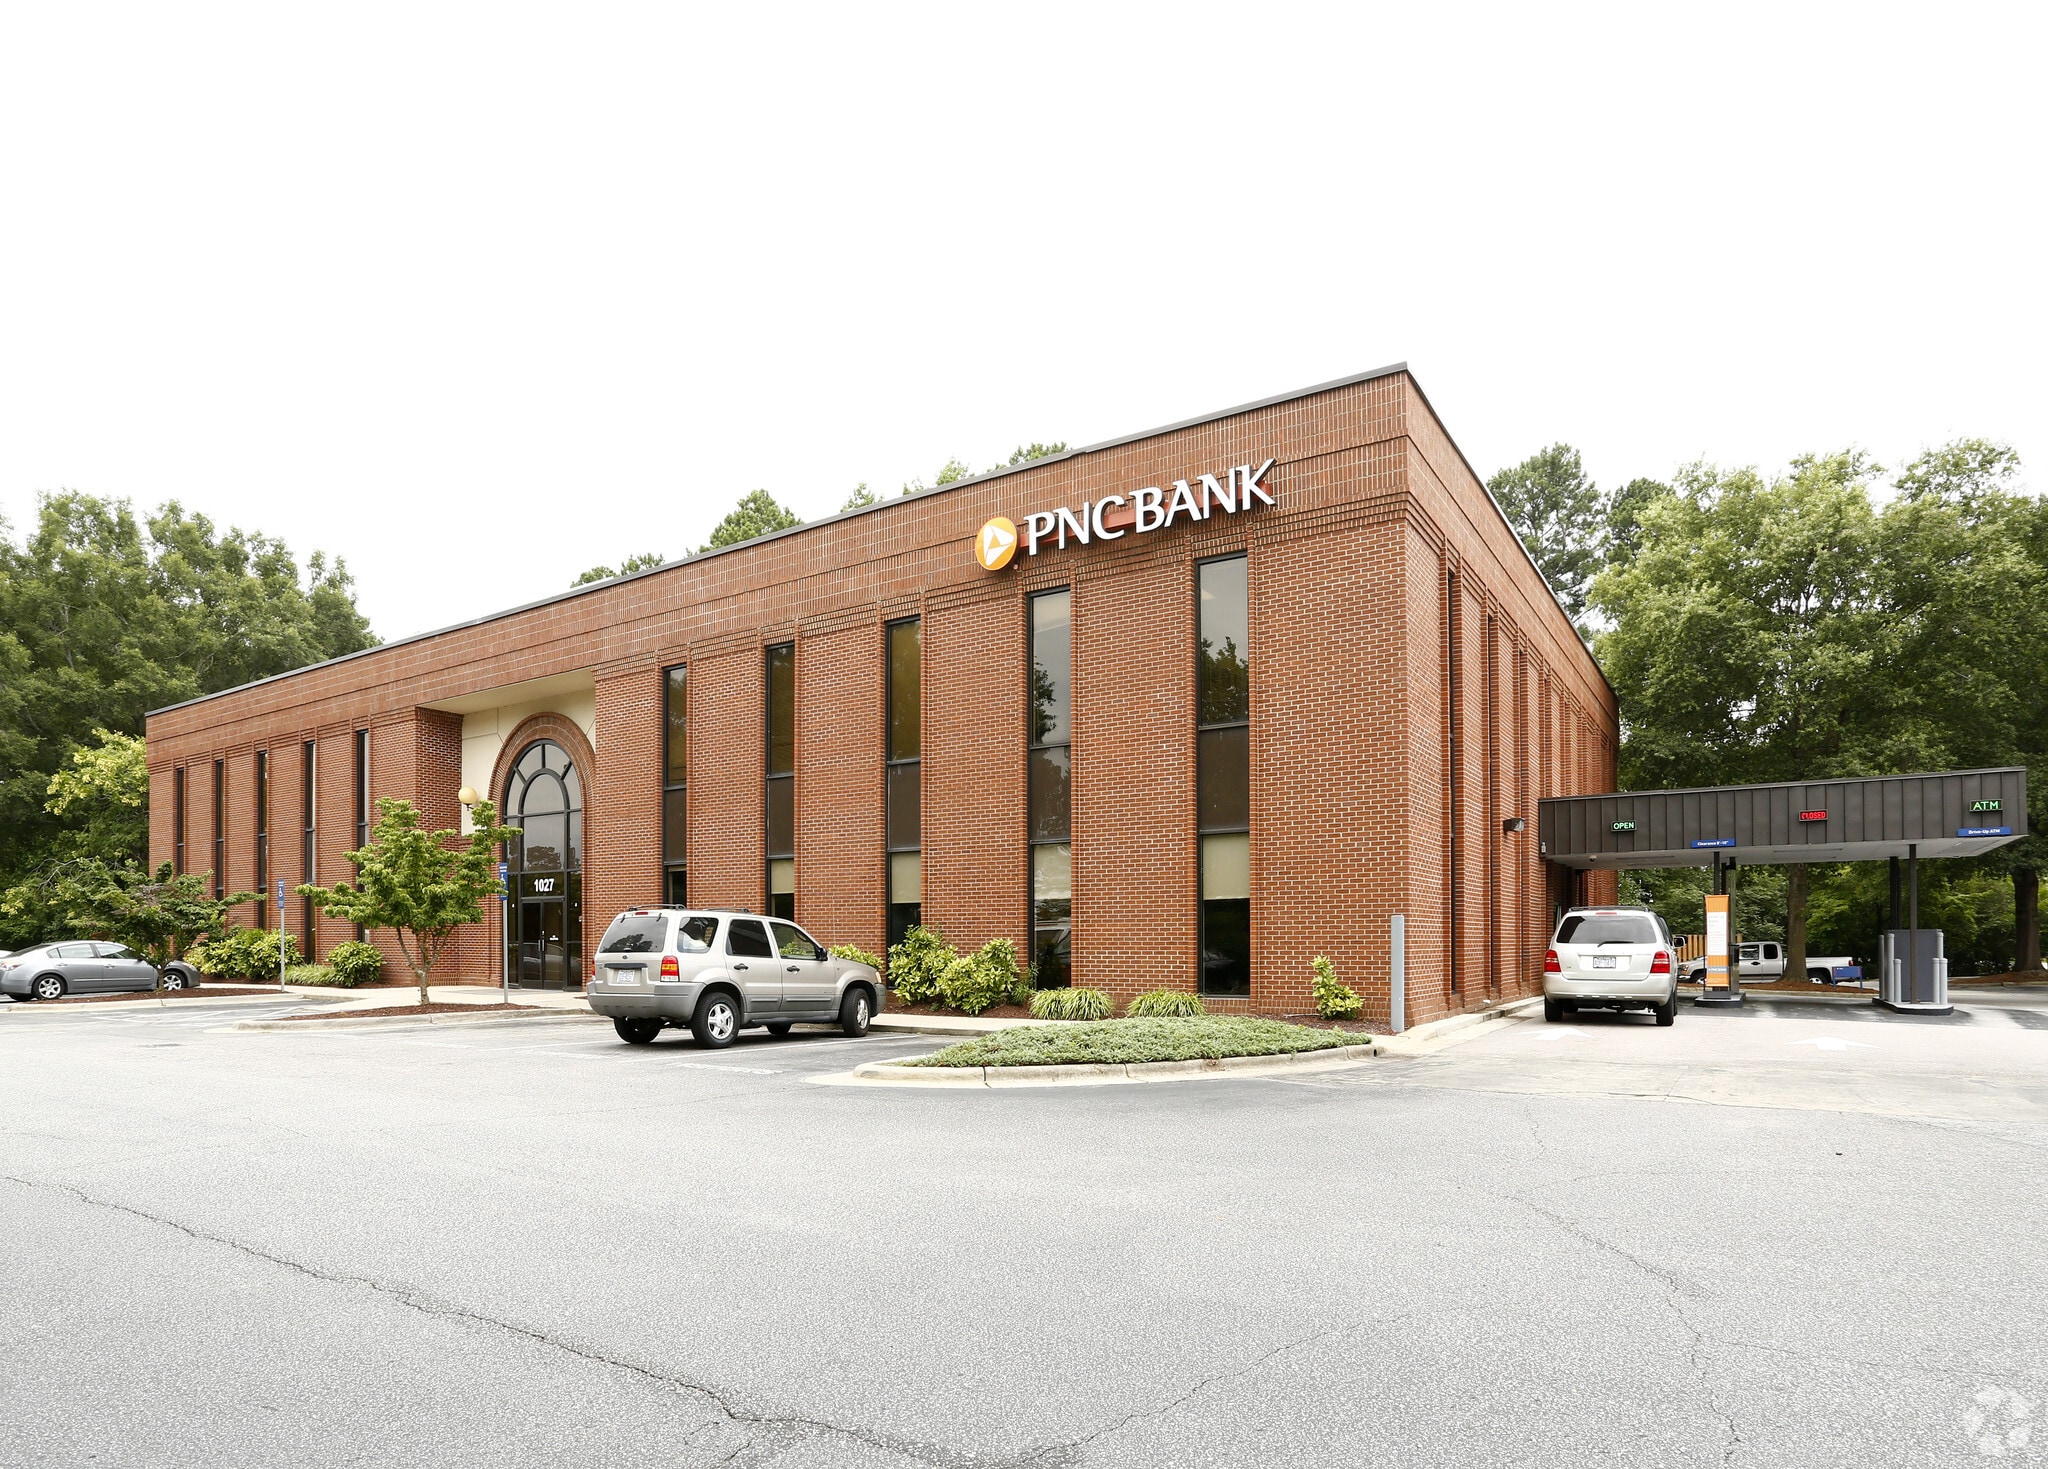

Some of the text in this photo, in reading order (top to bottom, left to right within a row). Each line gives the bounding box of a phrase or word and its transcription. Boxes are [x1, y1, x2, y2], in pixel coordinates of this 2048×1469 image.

[1023, 458, 1277, 556] PNC BANK
[1973, 801, 1999, 811] ATM
[1801, 811, 1826, 820] CLOSED
[1613, 822, 1634, 830] OPEN
[533, 878, 555, 892] 1027
